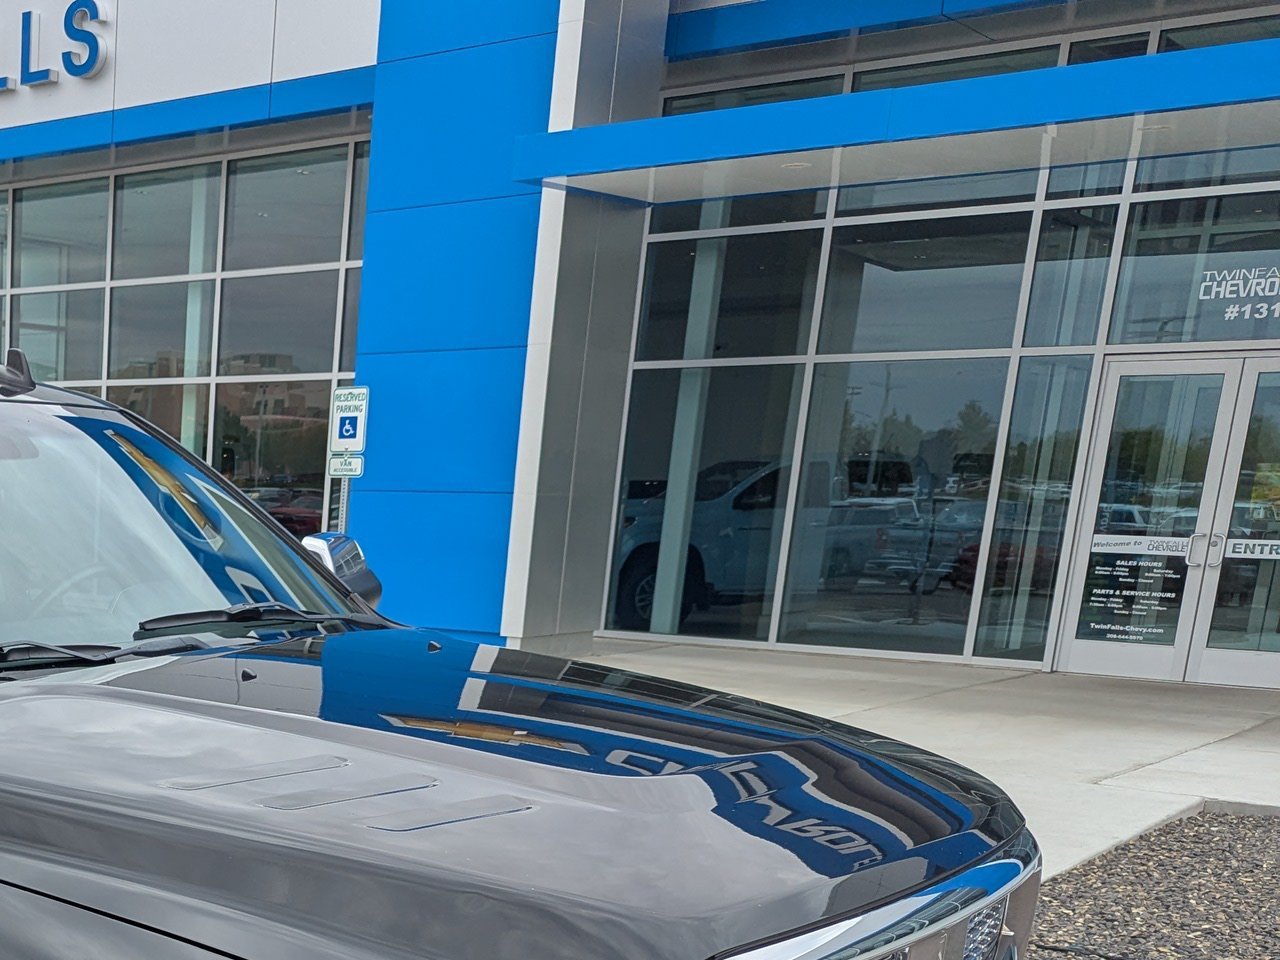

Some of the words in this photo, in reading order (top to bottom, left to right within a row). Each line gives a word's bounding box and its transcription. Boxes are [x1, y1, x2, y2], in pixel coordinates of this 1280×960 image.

[1199, 277, 1280, 300] CHEVRO
[1224, 302, 1280, 321] #131
[335, 392, 366, 402] RESERVED
[336, 404, 363, 414] PARKING
[1147, 543, 1187, 553] CHEVROLE
[1231, 543, 1280, 556] ENTR
